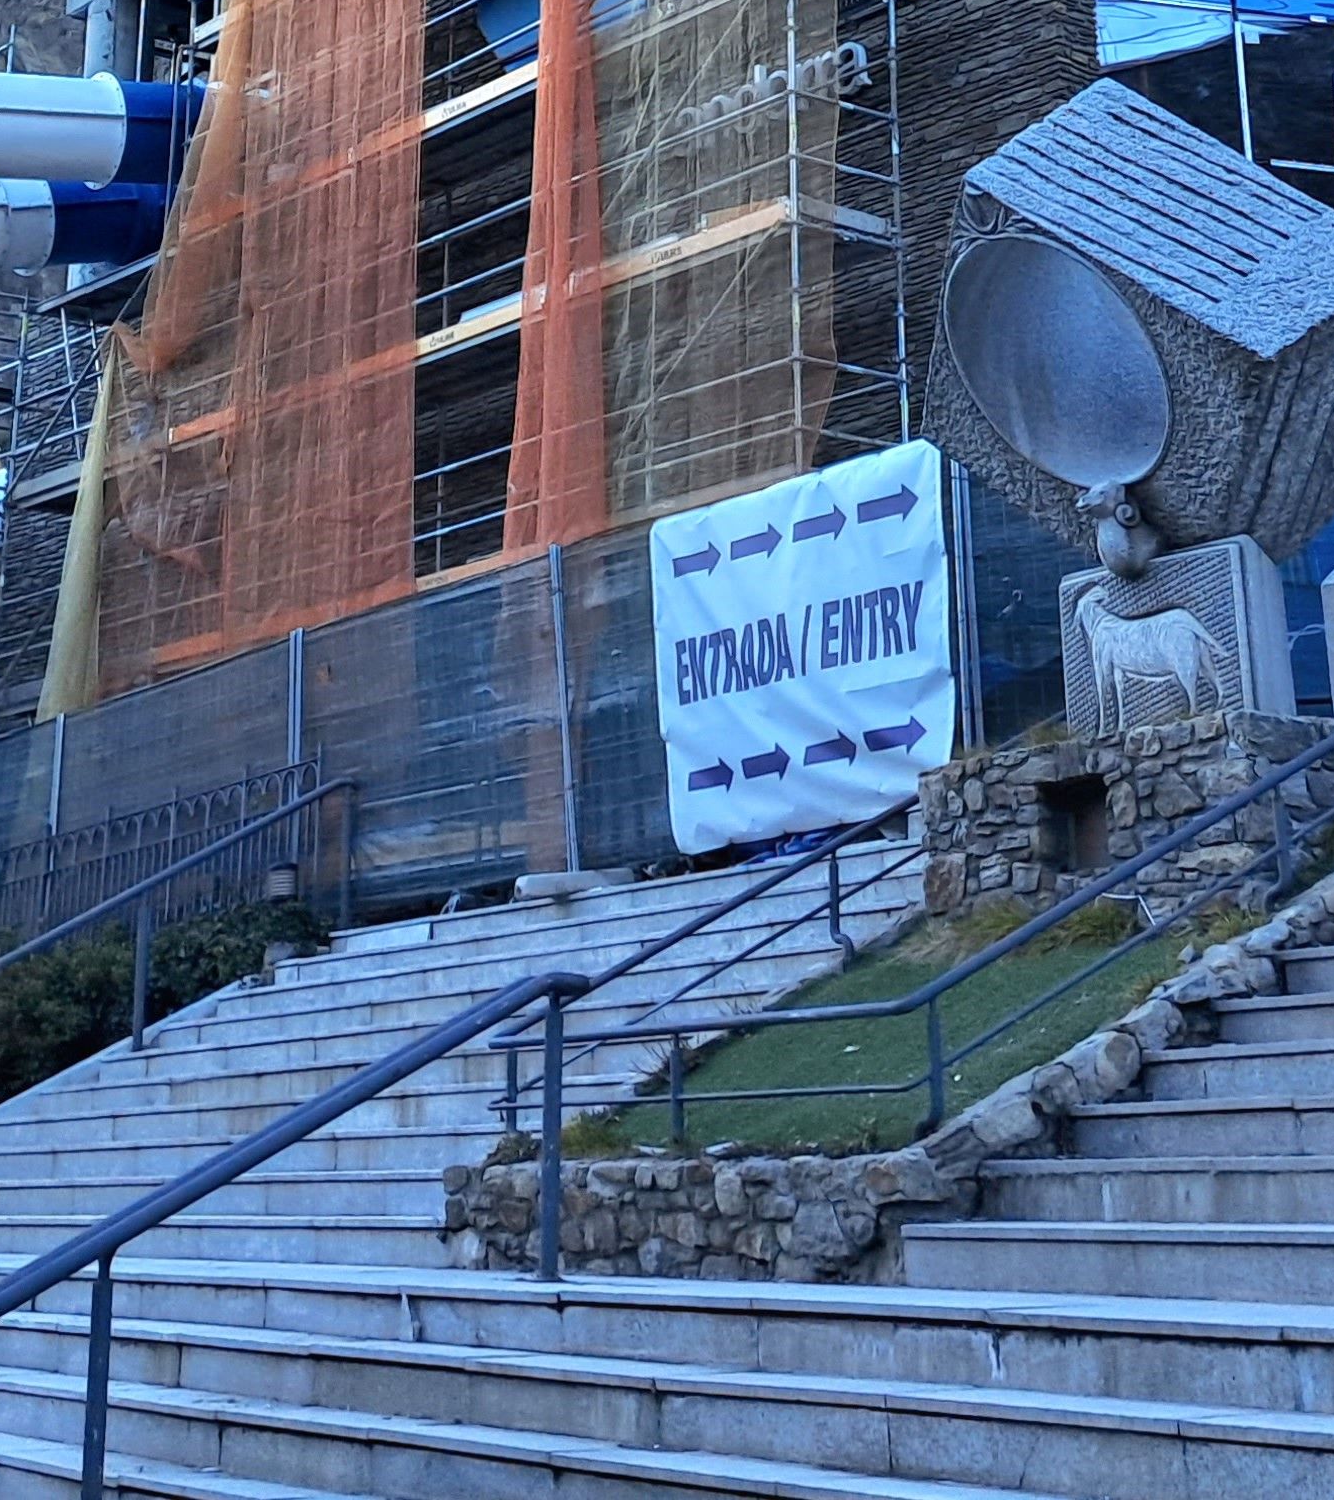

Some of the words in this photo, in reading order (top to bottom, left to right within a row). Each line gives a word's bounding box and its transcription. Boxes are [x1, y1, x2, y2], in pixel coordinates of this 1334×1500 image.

[674, 612, 796, 707] ENTRADA
[800, 604, 813, 677] /
[820, 579, 924, 670] ENTRY
